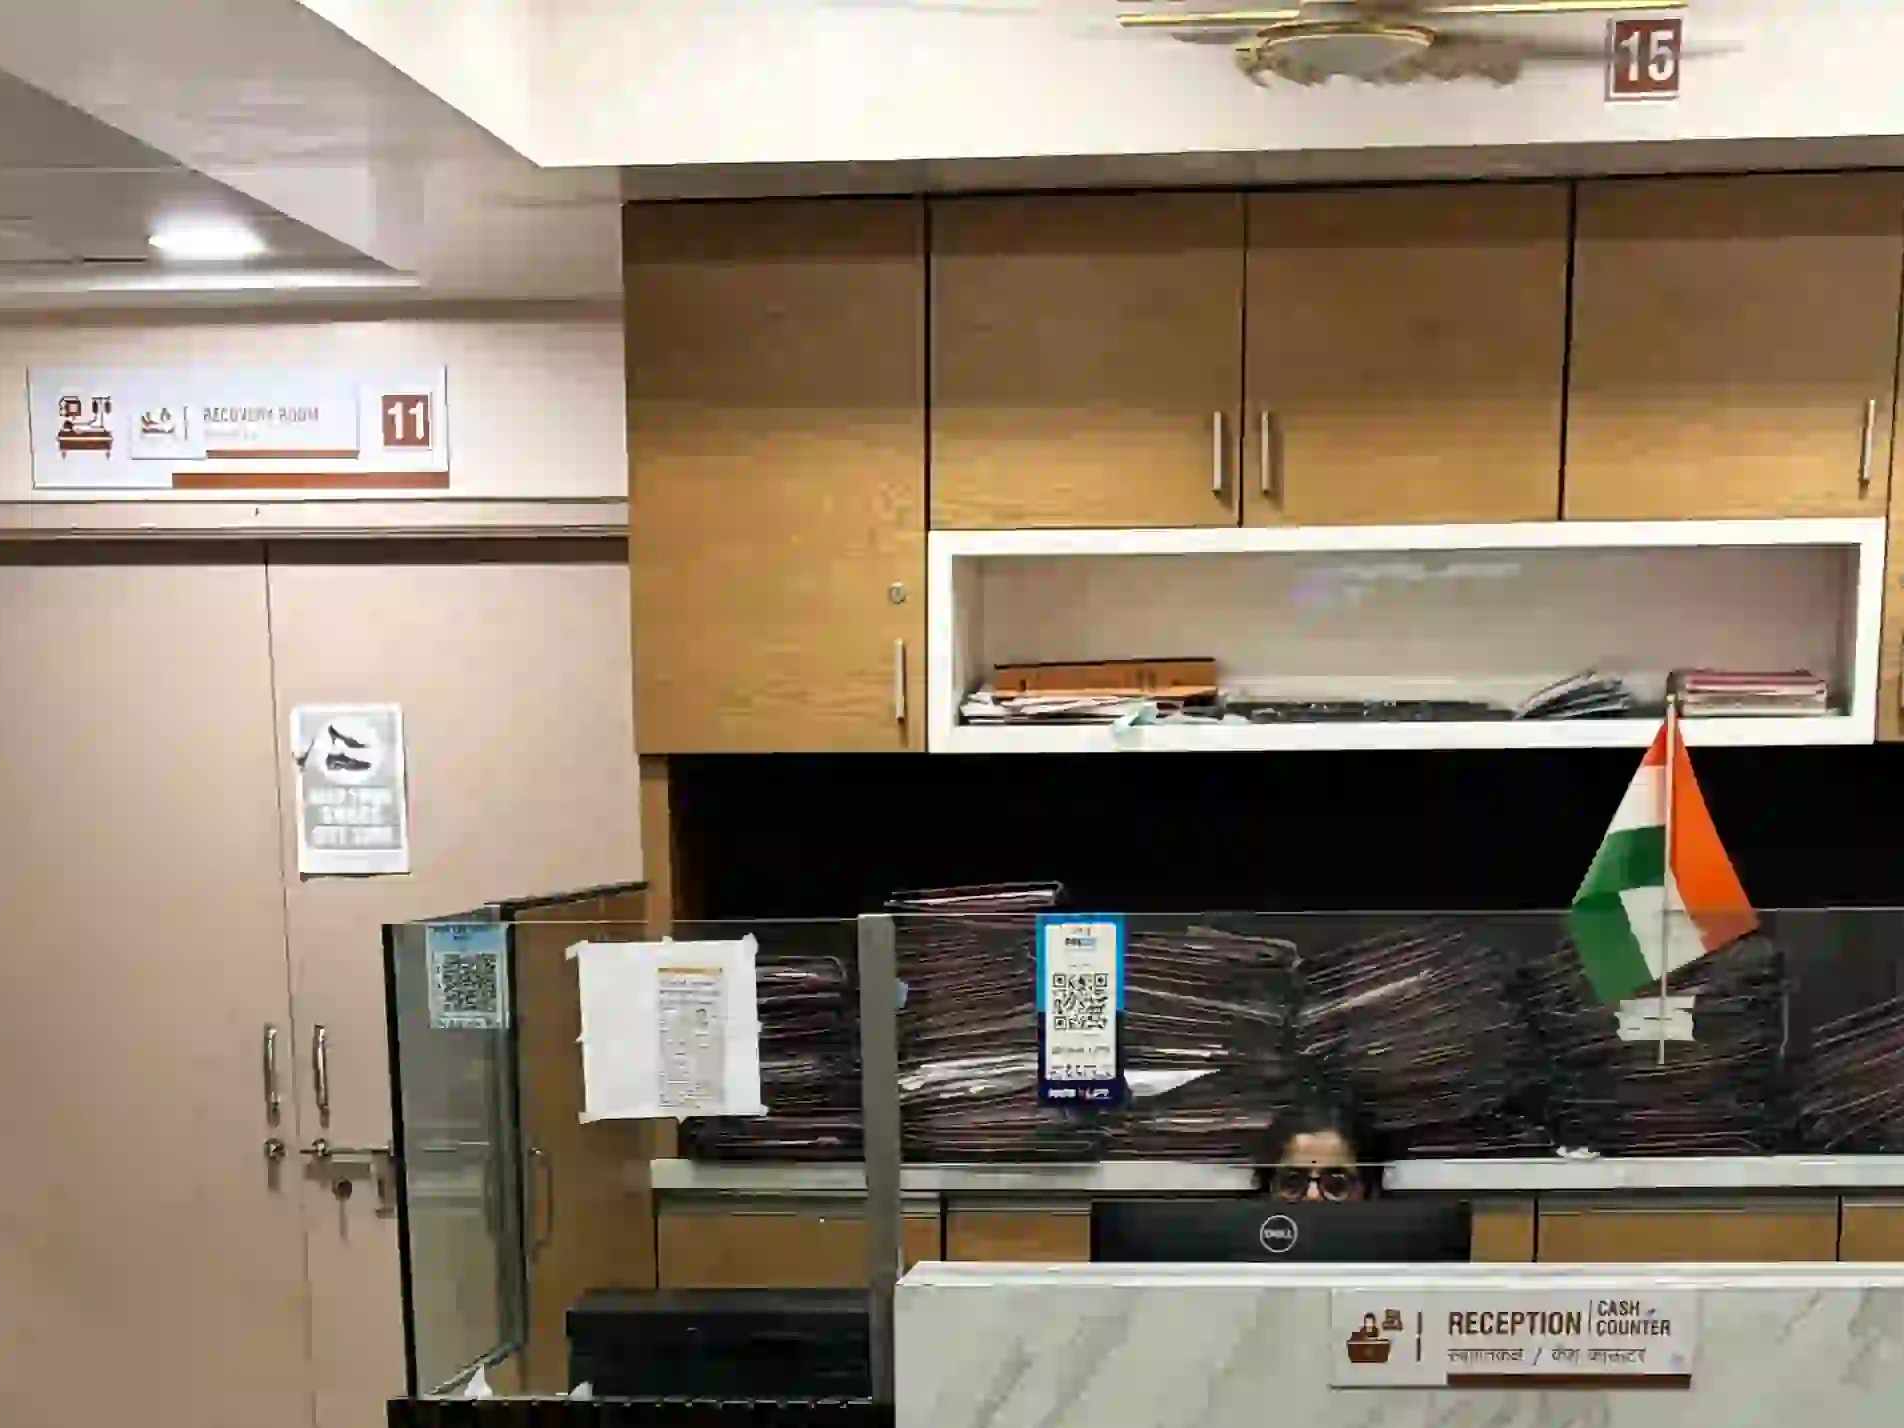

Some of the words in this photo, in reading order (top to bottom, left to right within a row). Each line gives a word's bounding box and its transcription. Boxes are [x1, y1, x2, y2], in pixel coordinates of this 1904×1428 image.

[1620, 29, 1675, 84] 15
[278, 406, 320, 423] ROOM
[386, 401, 426, 441] 11
[1597, 1300, 1641, 1318] CASH
[1447, 1310, 1583, 1337] RECEPTION
[1595, 1318, 1673, 1337] COUNTER
